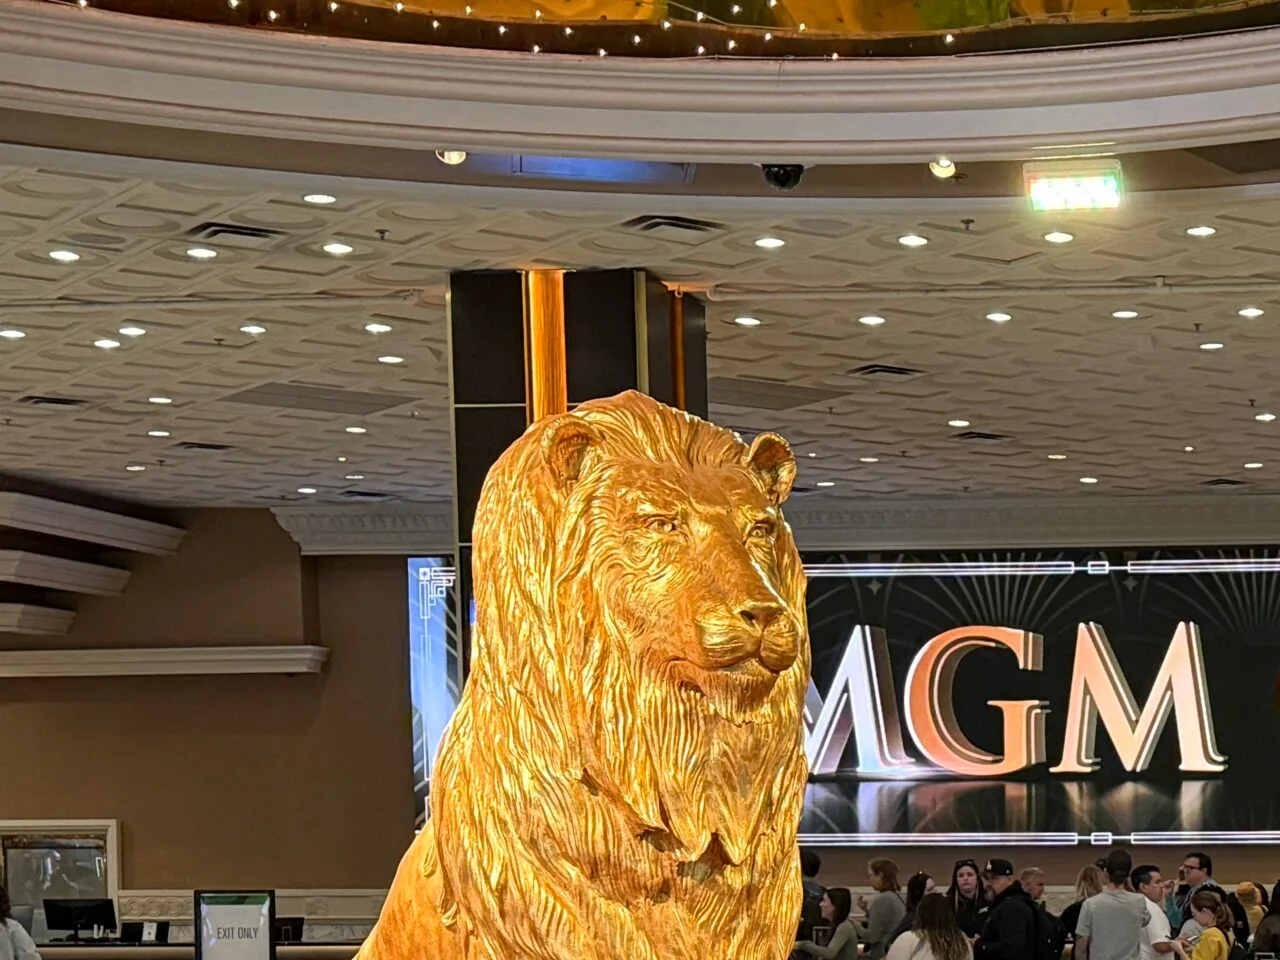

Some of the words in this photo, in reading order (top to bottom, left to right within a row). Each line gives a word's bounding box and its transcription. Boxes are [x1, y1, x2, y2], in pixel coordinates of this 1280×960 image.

[804, 622, 1228, 775] MGM
[217, 927, 235, 939] EXIT
[238, 927, 259, 939] ONLY
